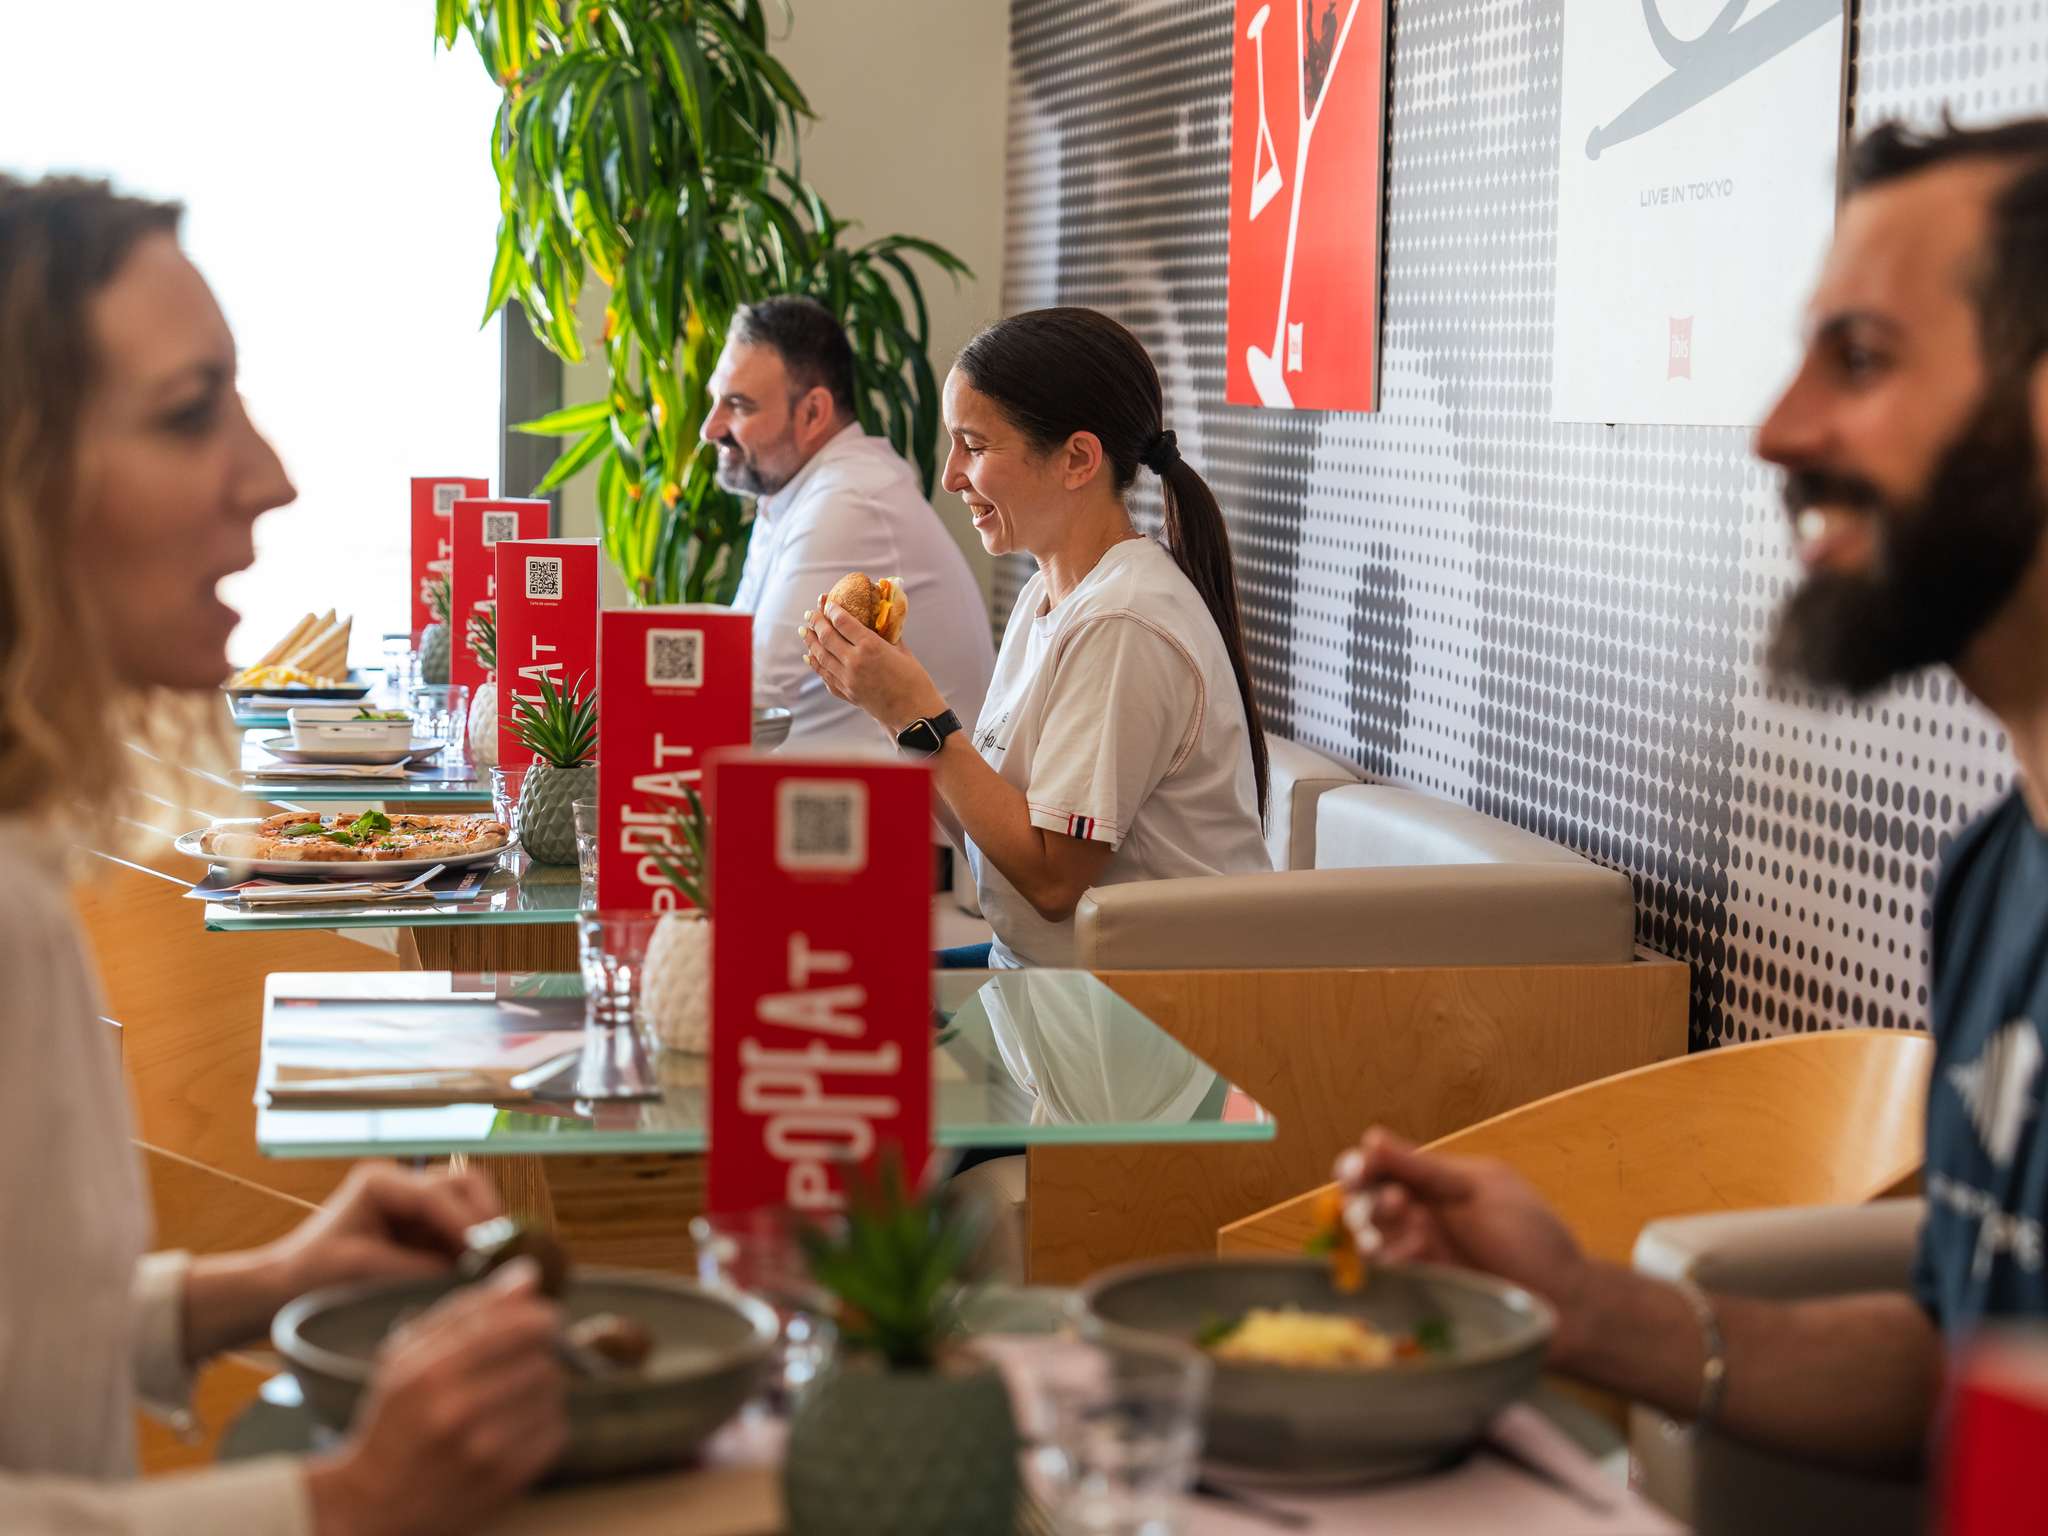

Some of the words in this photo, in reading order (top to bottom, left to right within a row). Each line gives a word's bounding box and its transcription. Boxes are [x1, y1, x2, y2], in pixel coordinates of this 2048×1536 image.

[1640, 187, 1669, 207] LIVE
[1672, 184, 1684, 202] IN
[1687, 179, 1733, 200] TOKYO
